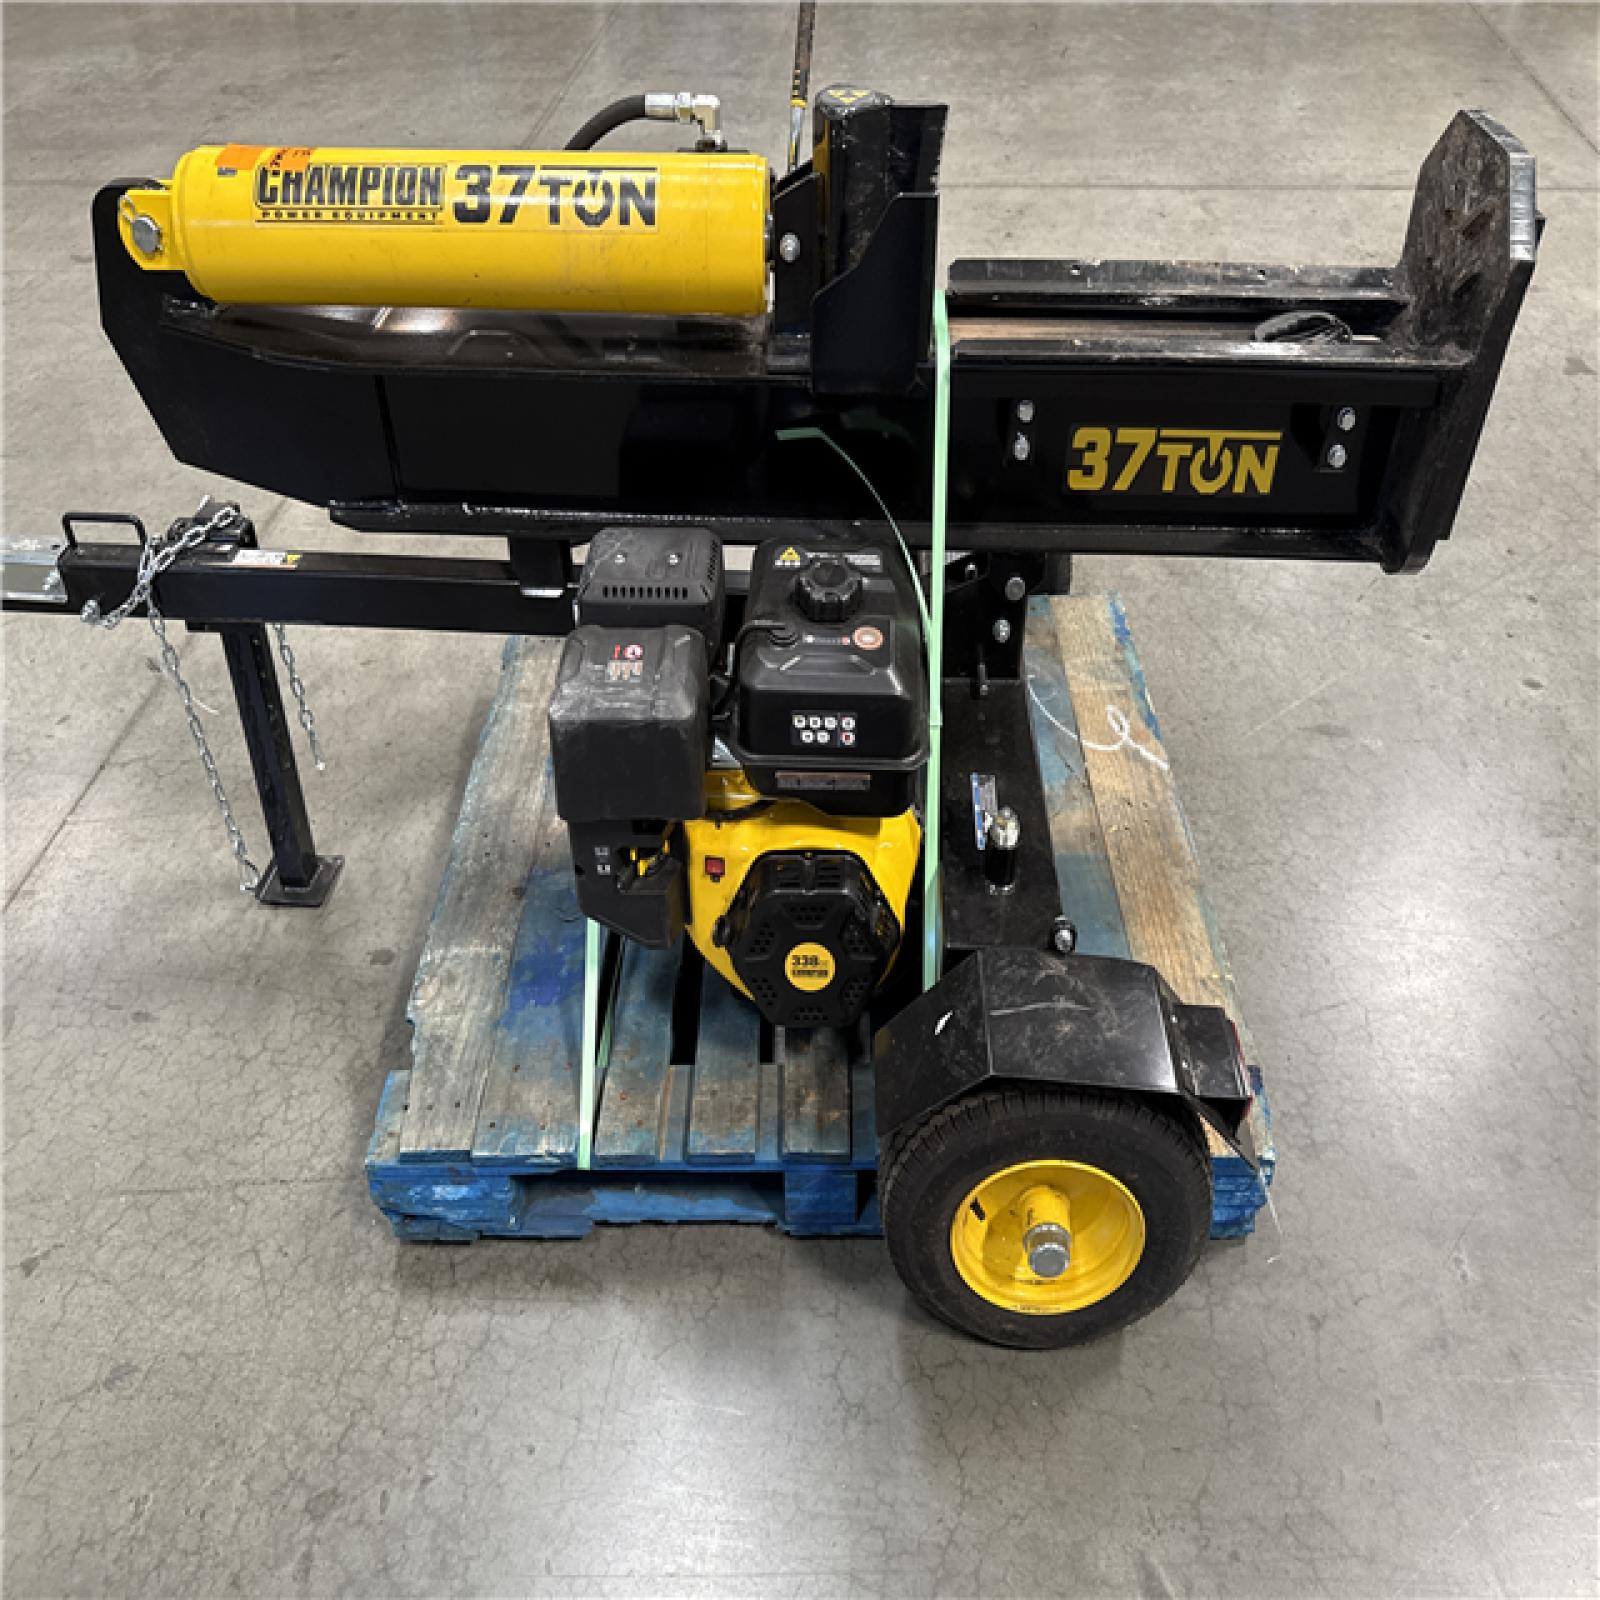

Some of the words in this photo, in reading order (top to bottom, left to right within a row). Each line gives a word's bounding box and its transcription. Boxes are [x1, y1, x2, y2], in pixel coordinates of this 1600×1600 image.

[258, 164, 442, 205] CHAMPION
[261, 210, 323, 219] POWER
[331, 210, 437, 220] EQUIPMENT
